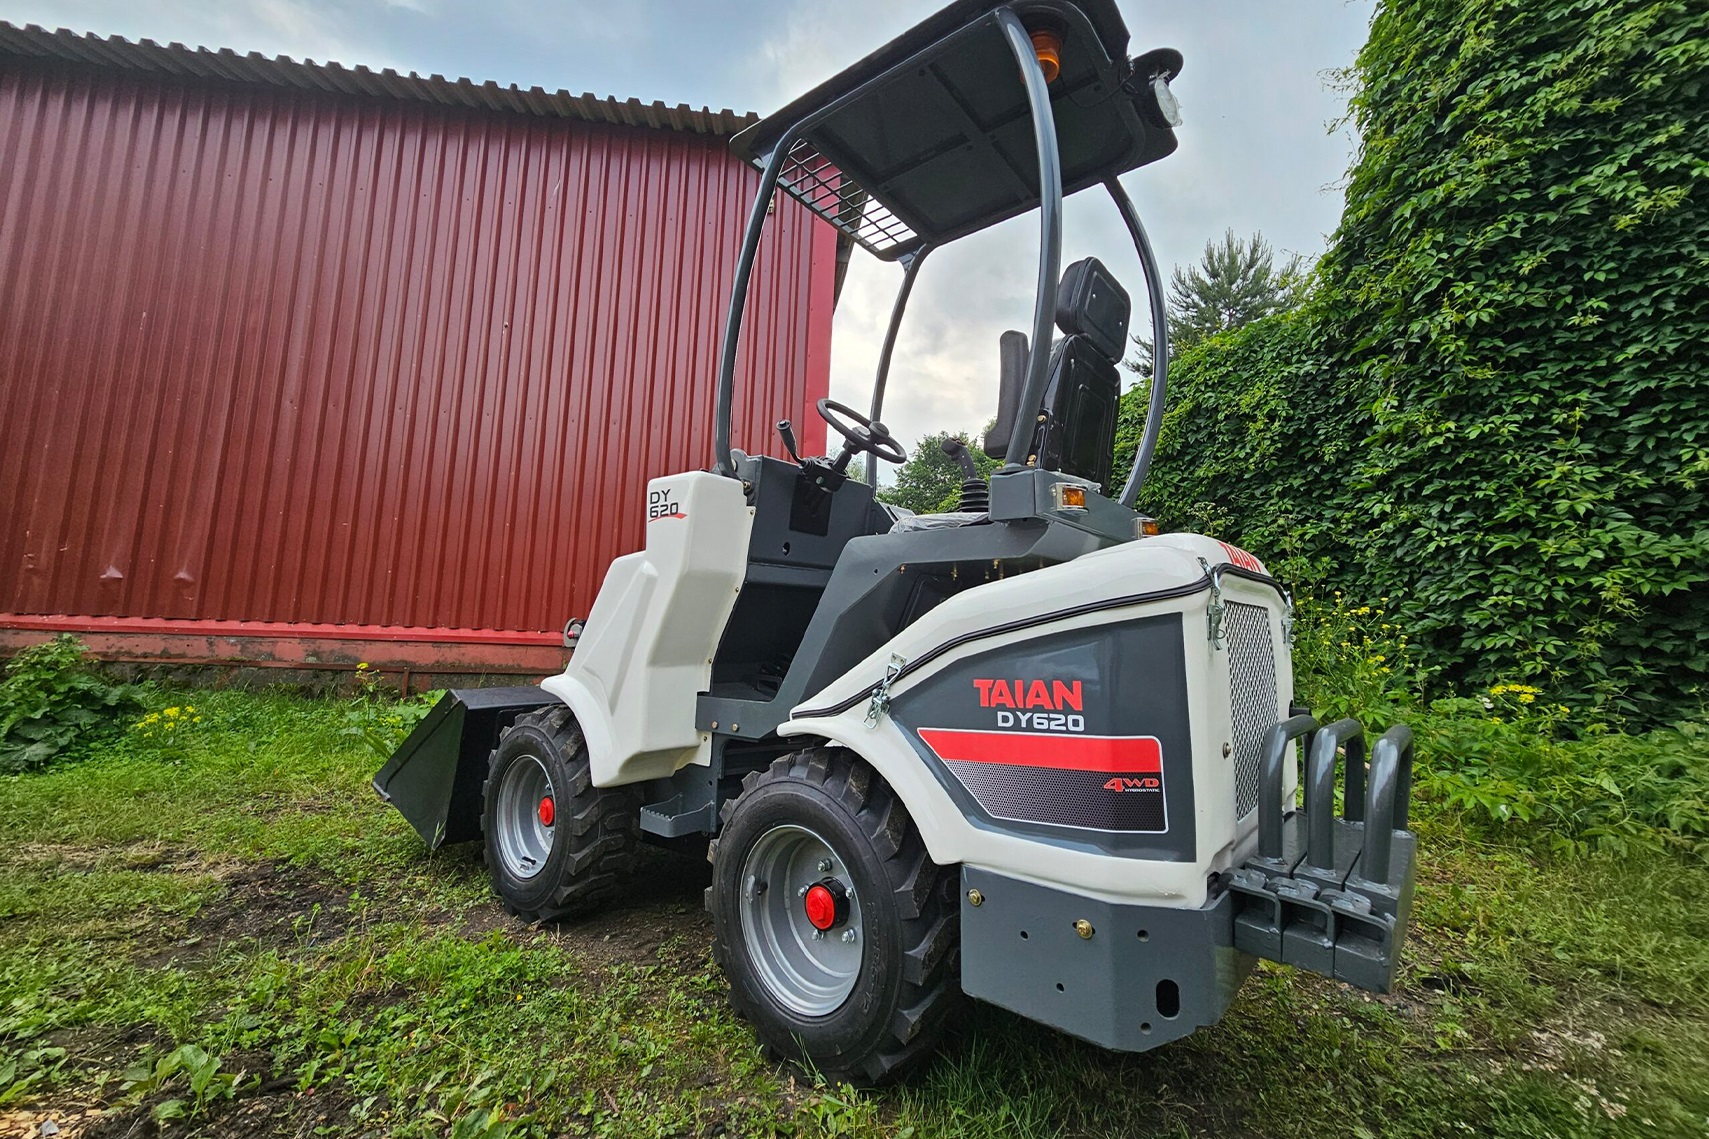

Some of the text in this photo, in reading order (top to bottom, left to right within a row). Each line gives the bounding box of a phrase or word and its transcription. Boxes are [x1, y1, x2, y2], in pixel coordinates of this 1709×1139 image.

[650, 489, 671, 504] DY
[650, 502, 679, 518] 620
[973, 679, 1083, 711] TAIAN
[997, 711, 1085, 732] DY620
[1103, 777, 1160, 792] 4WD
